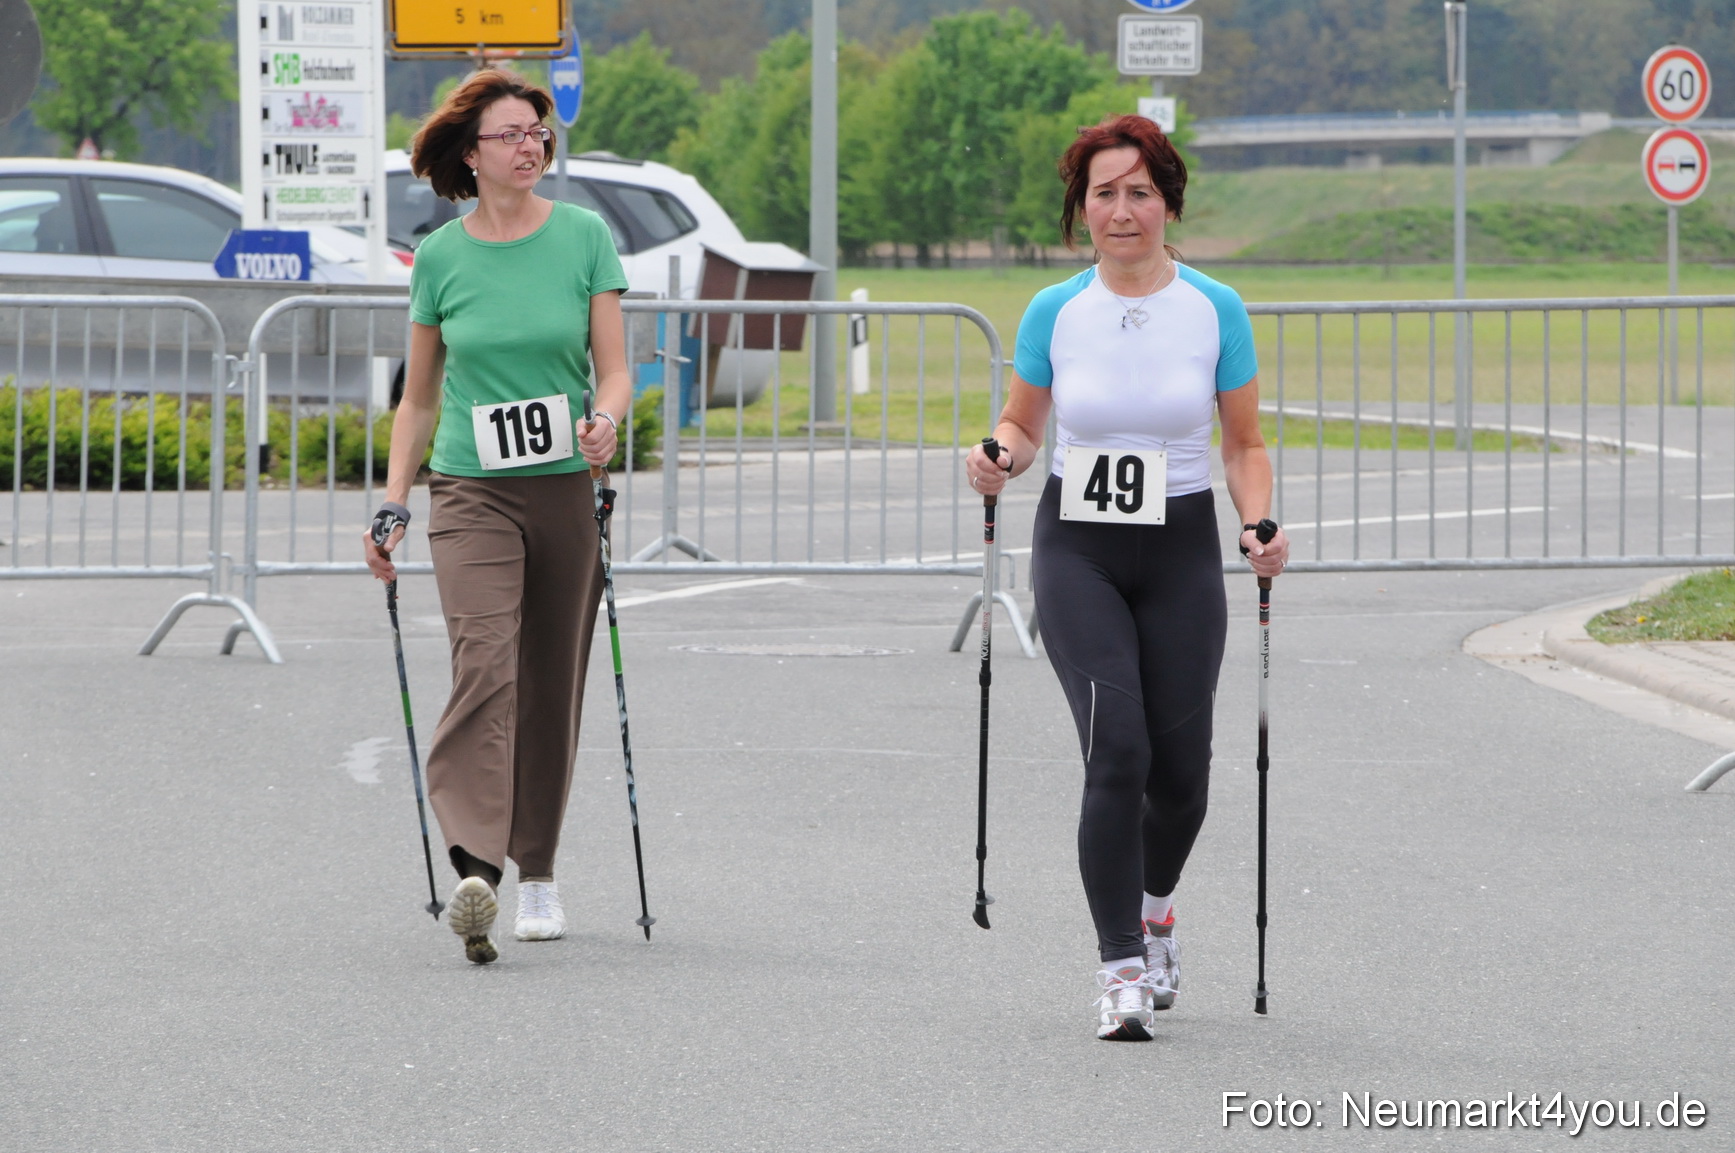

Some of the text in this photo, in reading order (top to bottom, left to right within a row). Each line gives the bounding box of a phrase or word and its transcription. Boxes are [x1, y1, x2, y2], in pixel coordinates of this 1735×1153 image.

[455, 8, 504, 25] 5 km
[1132, 24, 1187, 38] Landwirt-
[1128, 40, 1191, 52] schaftlicher
[274, 53, 301, 86] SHB
[1127, 54, 1191, 67] Verkehr frei
[1660, 69, 1694, 101] 60
[234, 253, 302, 280] VOLVO
[489, 402, 553, 459] 119
[1083, 455, 1145, 514] 49
